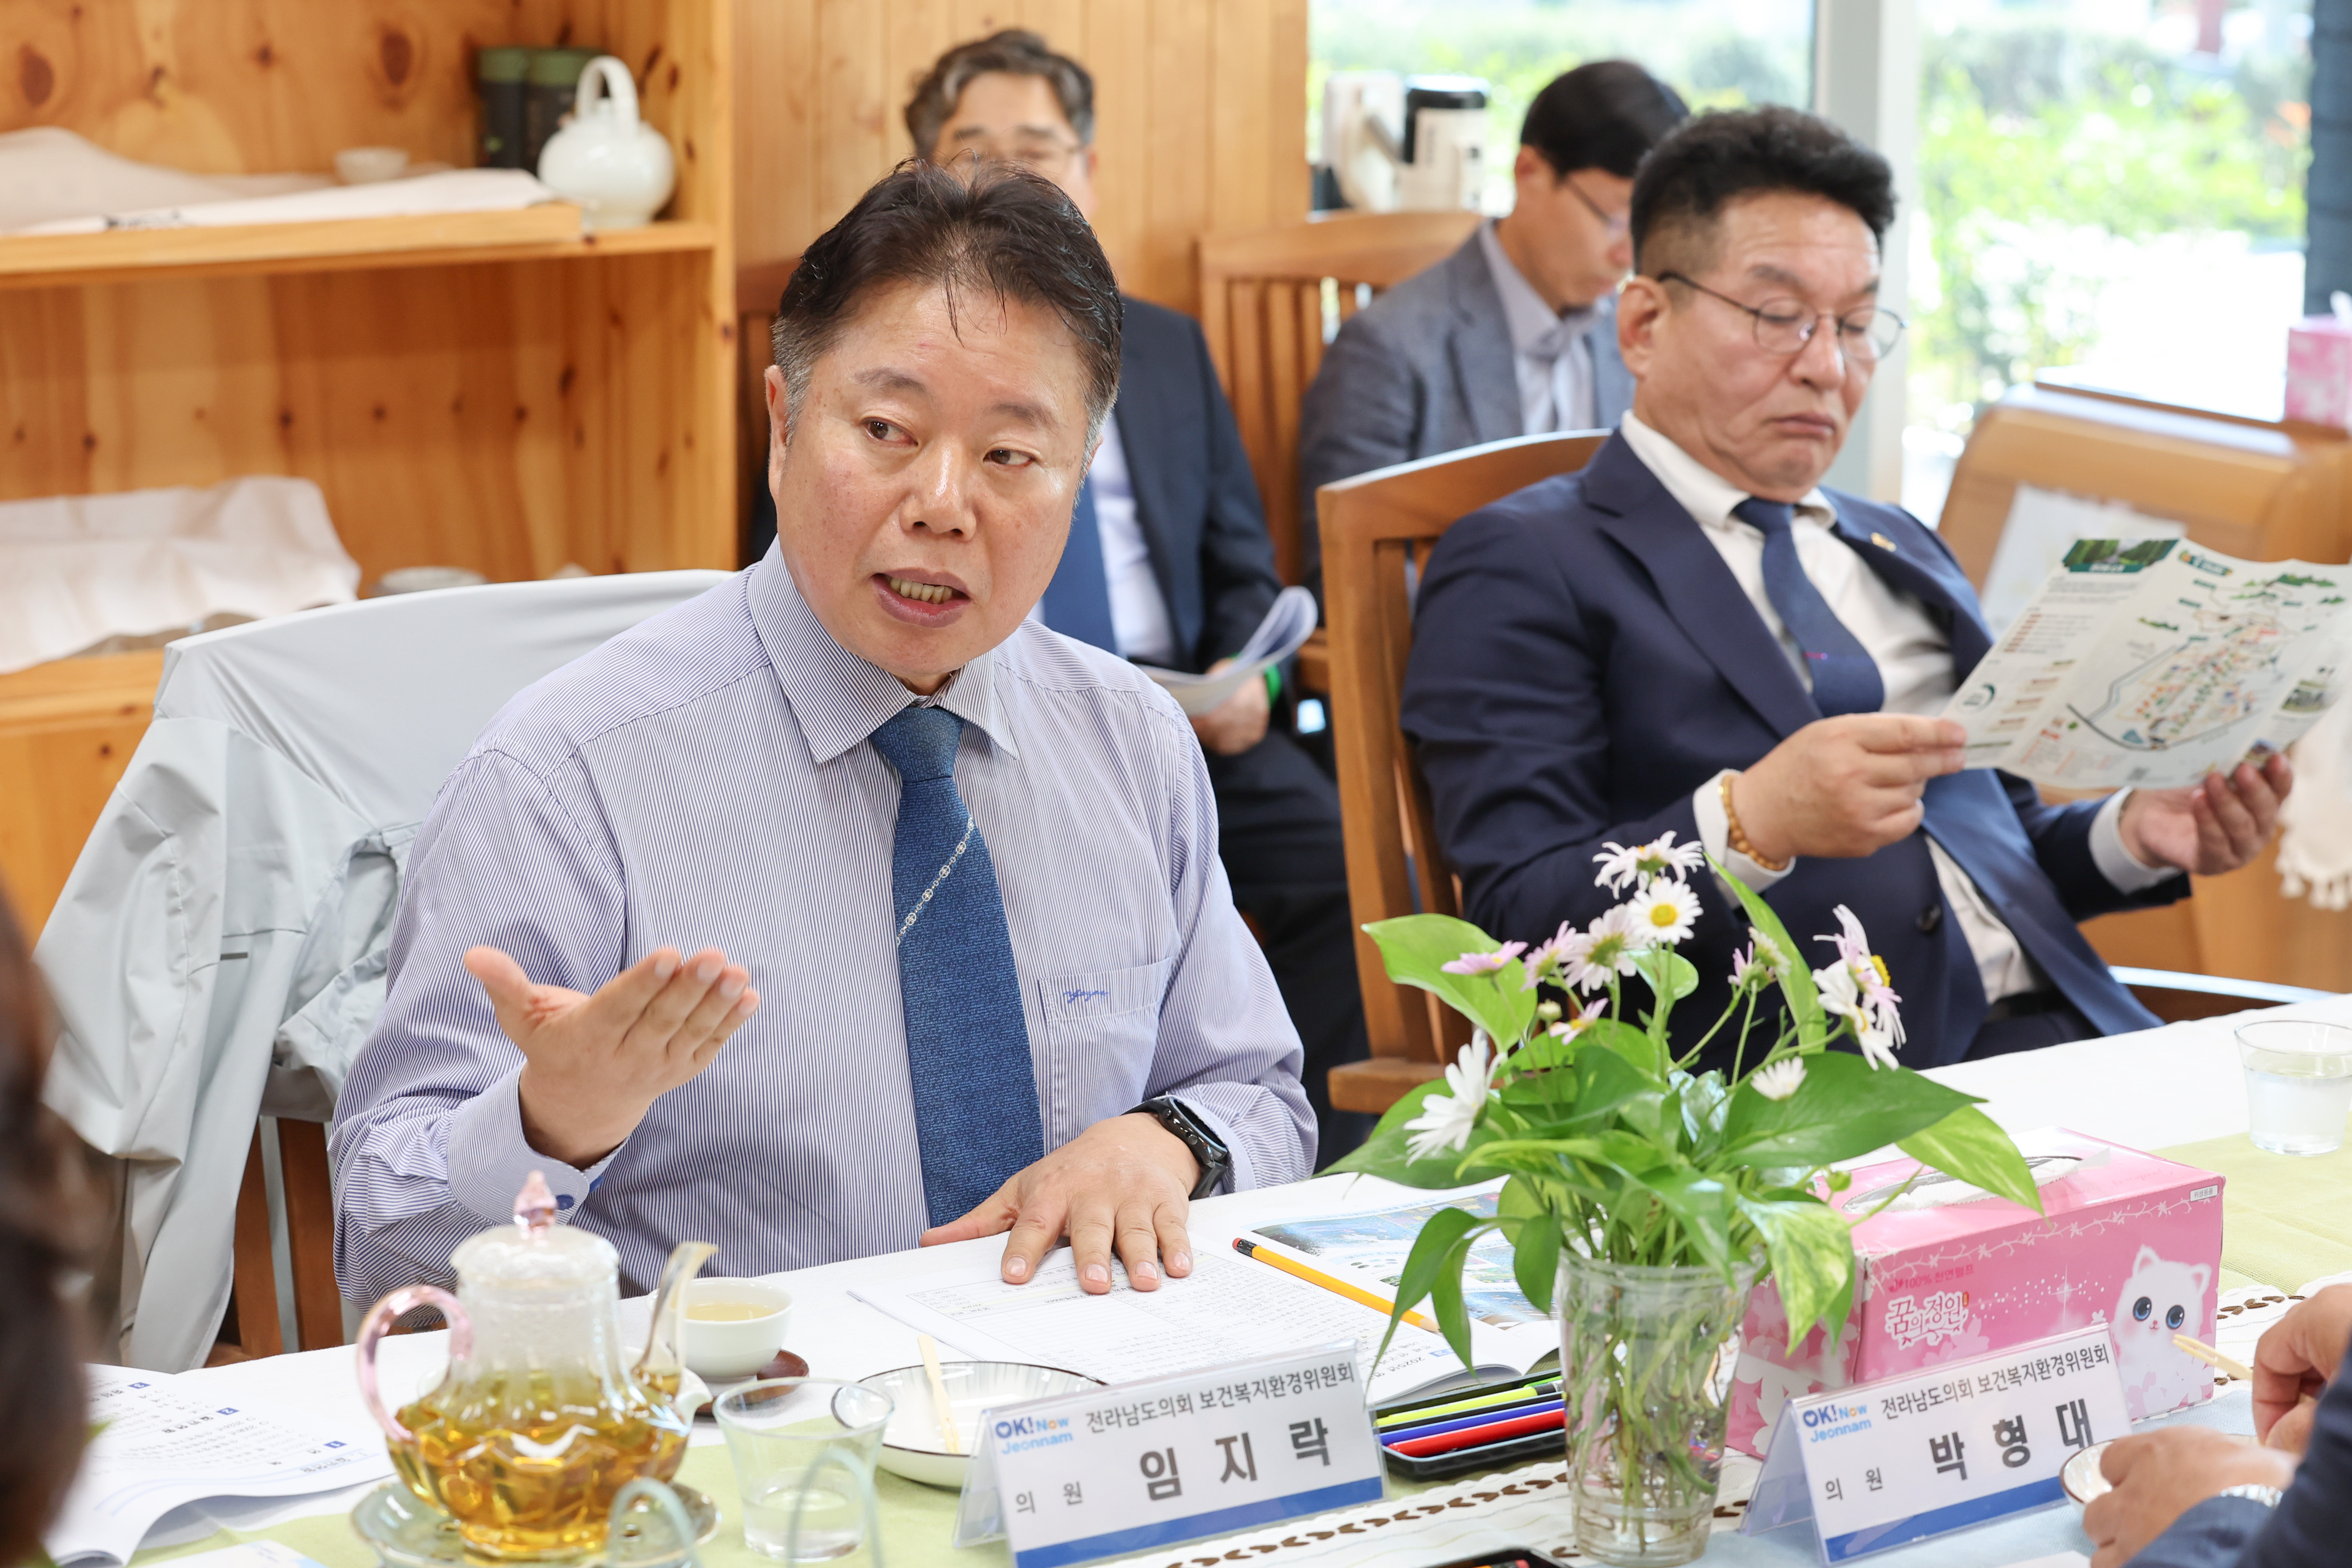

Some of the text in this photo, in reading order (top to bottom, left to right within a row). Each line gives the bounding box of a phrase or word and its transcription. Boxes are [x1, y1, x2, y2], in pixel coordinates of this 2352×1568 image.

[2194, 1187, 2213, 1198] 위생용품
[1906, 1273, 1932, 1289] 100%
[1386, 1357, 1425, 1372] 2025년
[1881, 1343, 2110, 1421] 전라남도의회 보건복지환경위원회
[1086, 1362, 1355, 1434] 전라남도의회 보건복지환경위원회
[996, 1416, 1034, 1438] OK!
[1803, 1405, 1837, 1427] OK!
[1811, 1419, 1872, 1442] Jeonnam
[1002, 1433, 1073, 1454] Jeonnam
